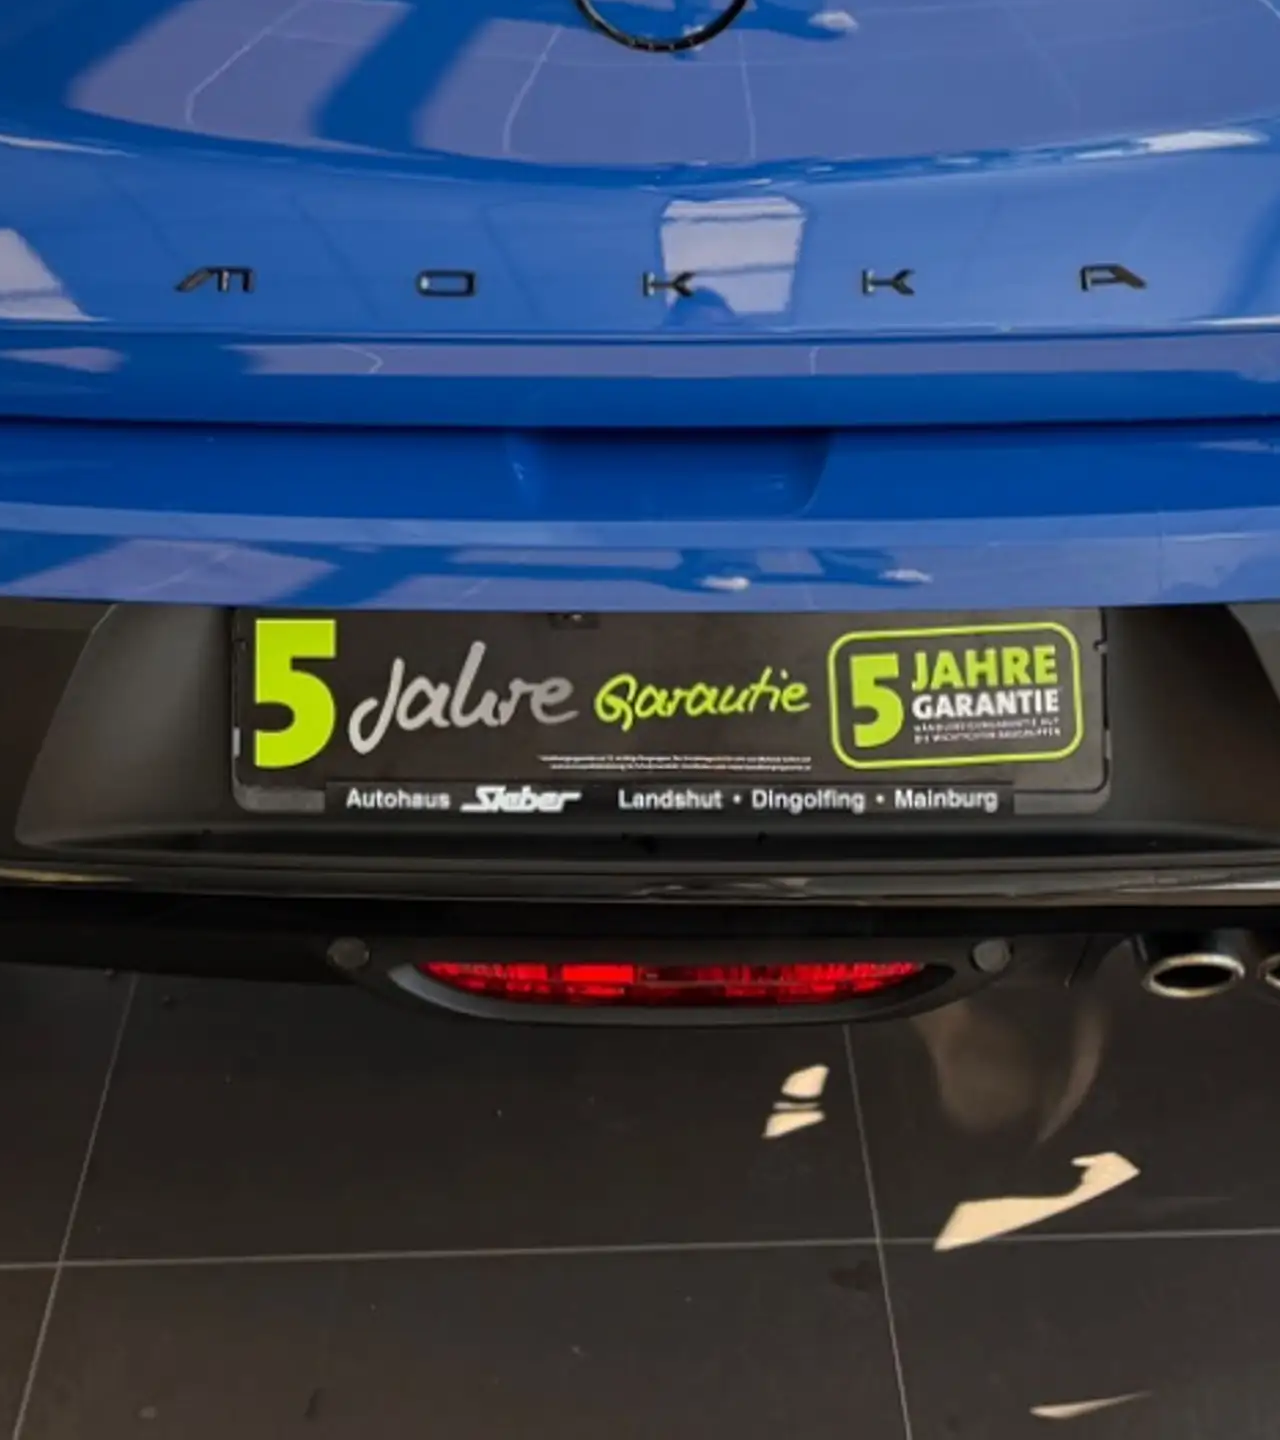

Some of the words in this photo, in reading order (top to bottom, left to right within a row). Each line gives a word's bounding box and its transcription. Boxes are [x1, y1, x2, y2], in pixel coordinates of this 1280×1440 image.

[255, 619, 336, 768] 5
[348, 640, 580, 754] Jahre
[594, 665, 811, 732] Garantie
[850, 652, 904, 748] 5
[911, 645, 1058, 692] JAHRE
[911, 688, 1060, 720] GARANTIE
[345, 788, 451, 808] Autohaus
[618, 789, 723, 809] Landshut
[751, 789, 865, 814] Dingolfing
[894, 790, 998, 813] Mainburg
